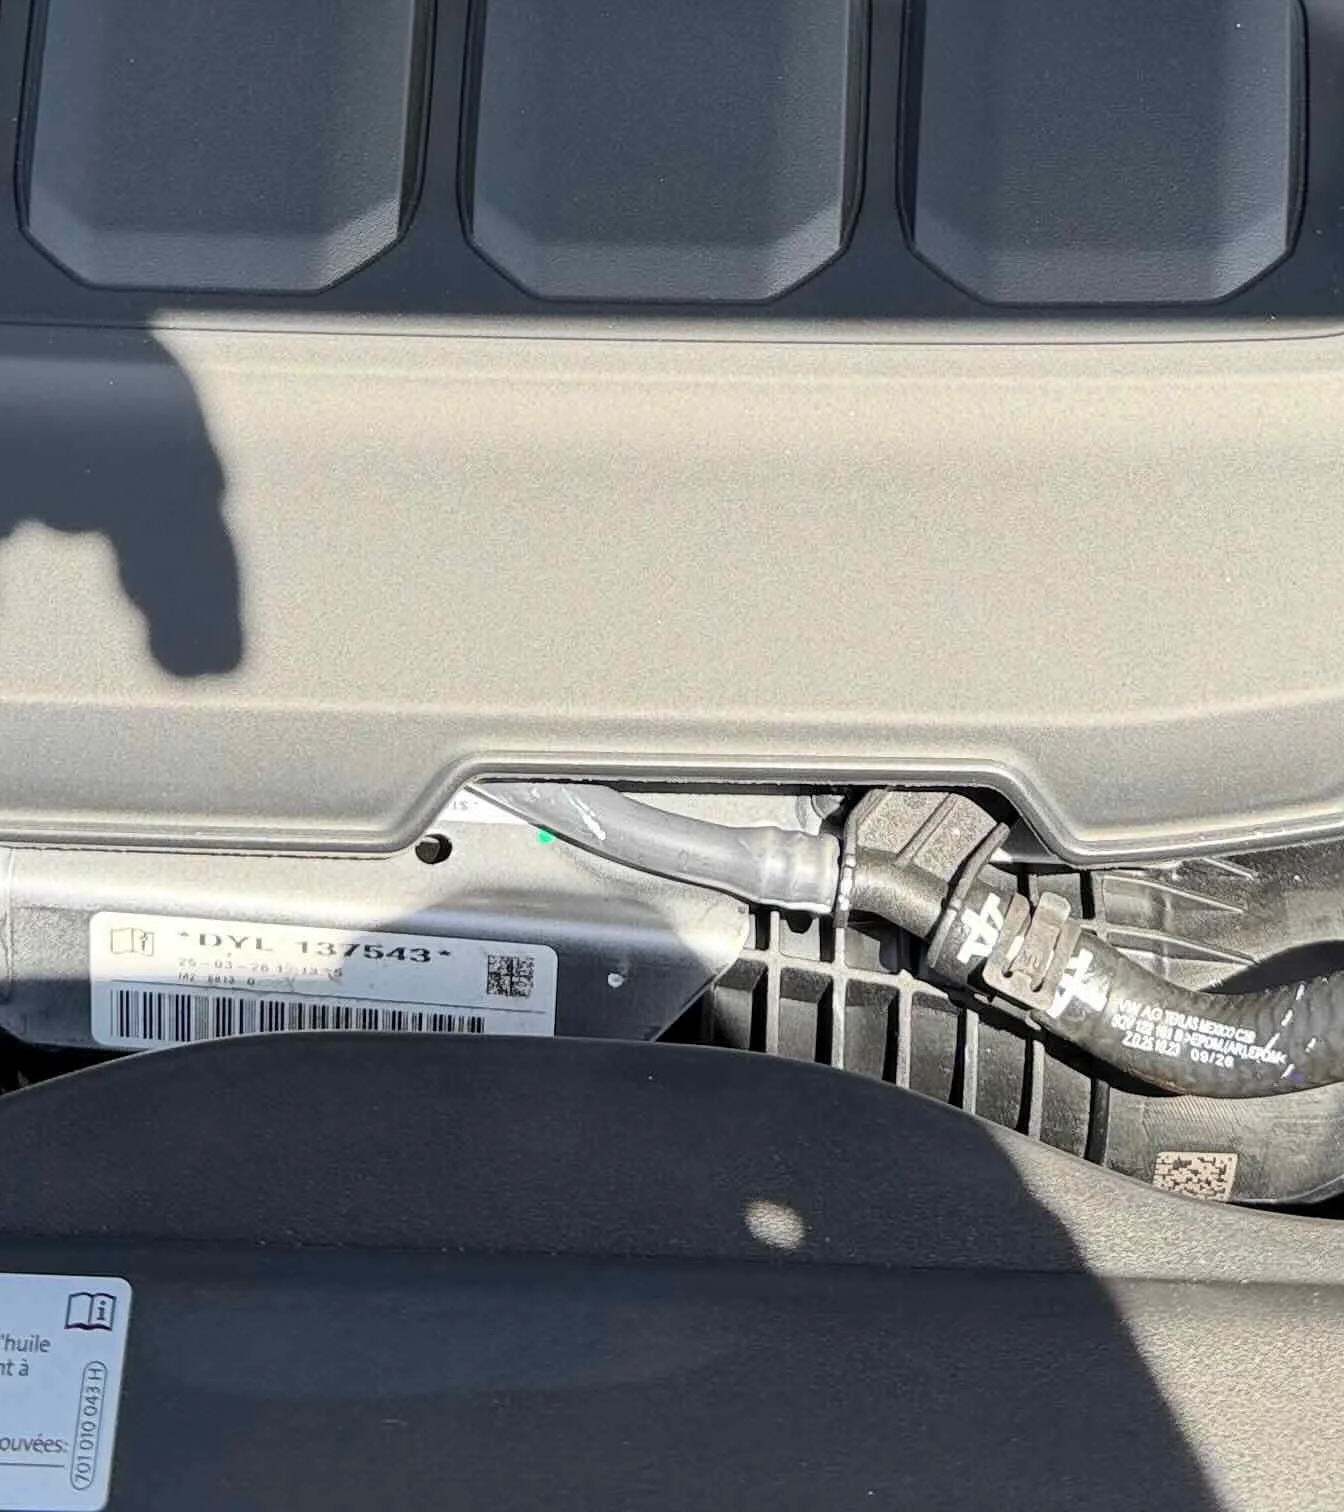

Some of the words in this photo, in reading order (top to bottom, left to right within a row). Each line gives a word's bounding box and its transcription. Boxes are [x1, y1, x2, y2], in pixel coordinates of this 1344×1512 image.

[17, 1358, 29, 1377] à
[86, 1367, 103, 1381] H
[82, 1385, 101, 1417] 043
[78, 1420, 97, 1450] 010
[74, 1454, 93, 1483] 701
